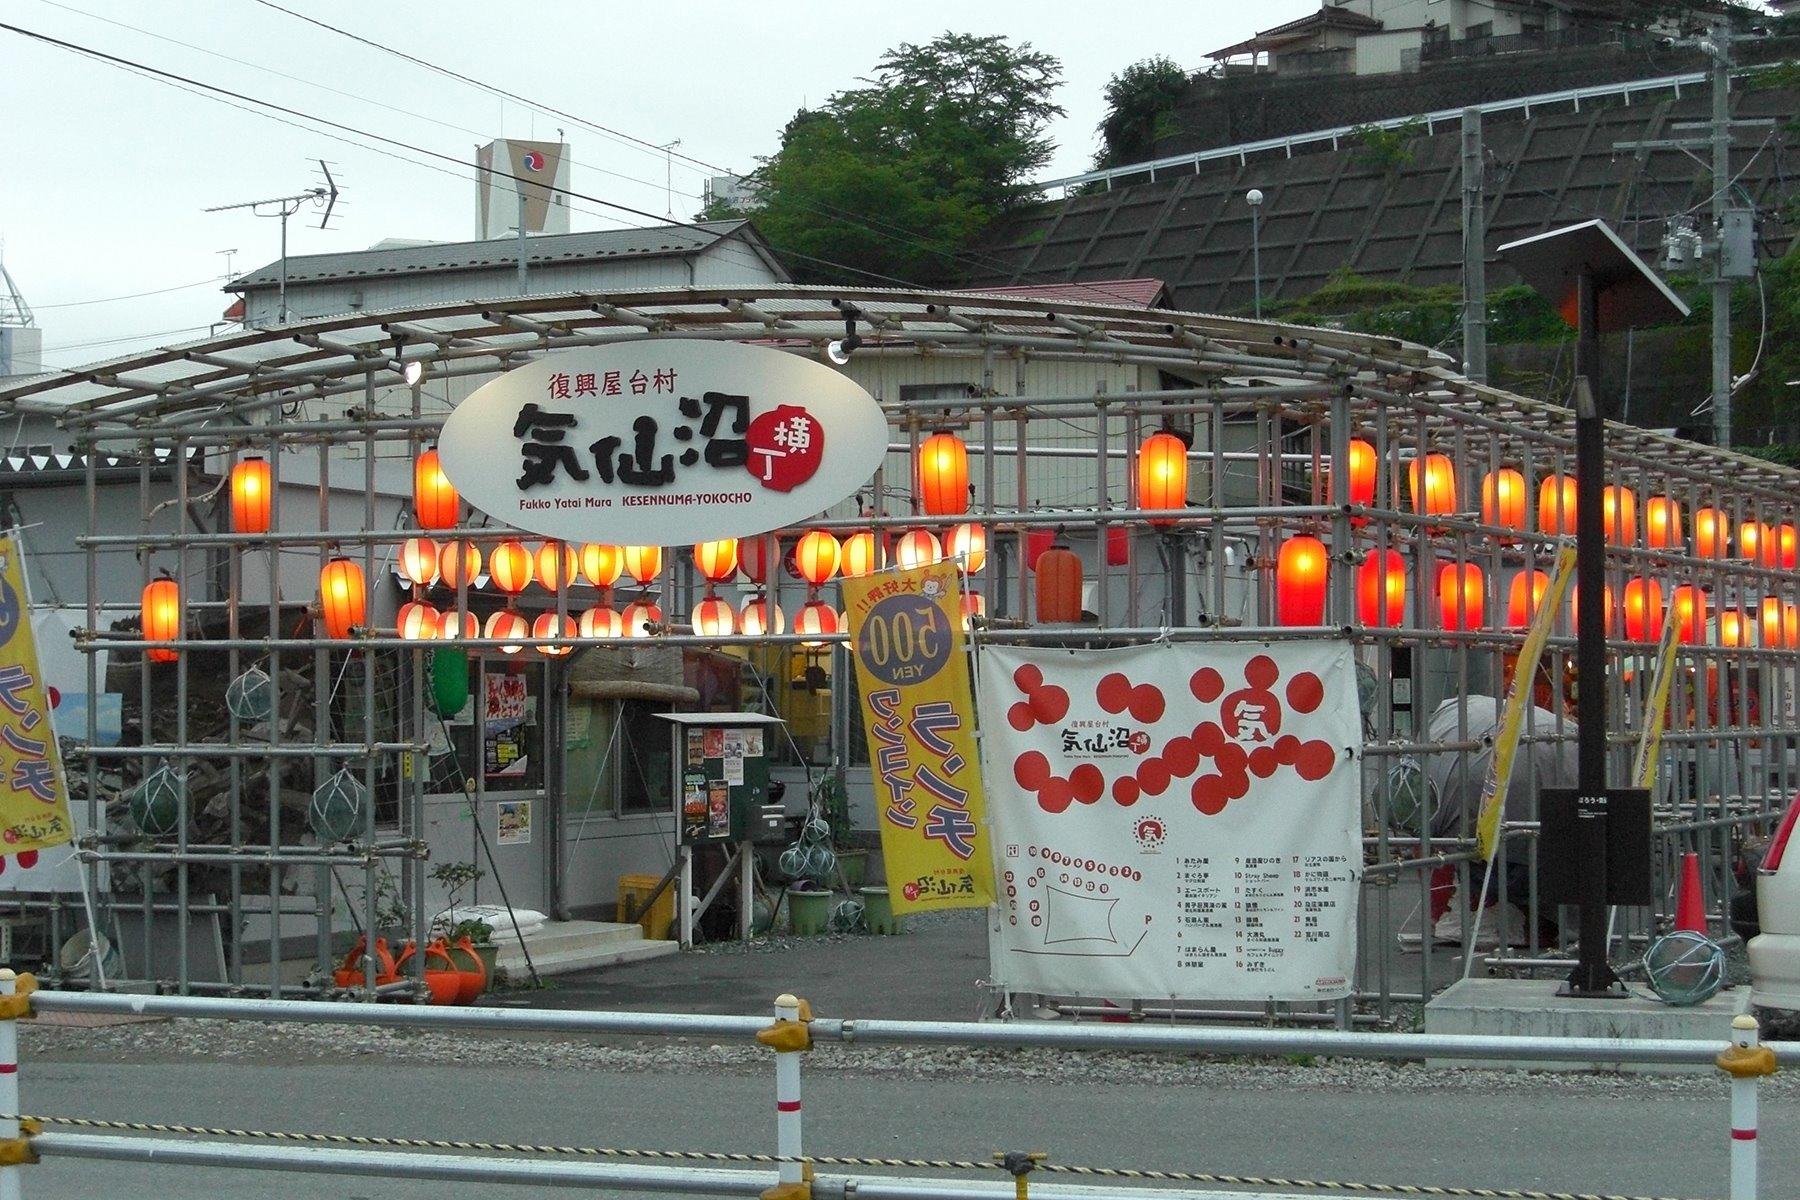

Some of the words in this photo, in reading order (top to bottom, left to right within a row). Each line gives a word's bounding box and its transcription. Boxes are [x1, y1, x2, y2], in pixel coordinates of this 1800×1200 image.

[547, 368, 679, 400] 復興屋台村
[513, 391, 751, 492] 気仙沼
[752, 416, 811, 481] 横丁
[519, 499, 551, 511] Fukko
[554, 497, 582, 509] Yatai
[585, 497, 612, 508] Mura
[622, 492, 753, 507] KESENNUMA-YOKOCHO
[1233, 699, 1275, 741] 気
[1061, 727, 1130, 753] 気仙沼
[1176, 886, 1181, 894] 3
[1234, 886, 1240, 894] 11
[1293, 885, 1301, 893] 19
[1177, 901, 1182, 909] 4
[1234, 901, 1242, 909] 12
[1294, 900, 1302, 908] 20
[1145, 915, 1152, 924] P
[1177, 916, 1182, 924] 5
[1235, 916, 1242, 924] 13
[1293, 915, 1300, 923] 21
[1294, 930, 1302, 938] 22
[1236, 945, 1242, 953] 15
[1177, 960, 1182, 968] 8
[1236, 960, 1243, 968] 16
